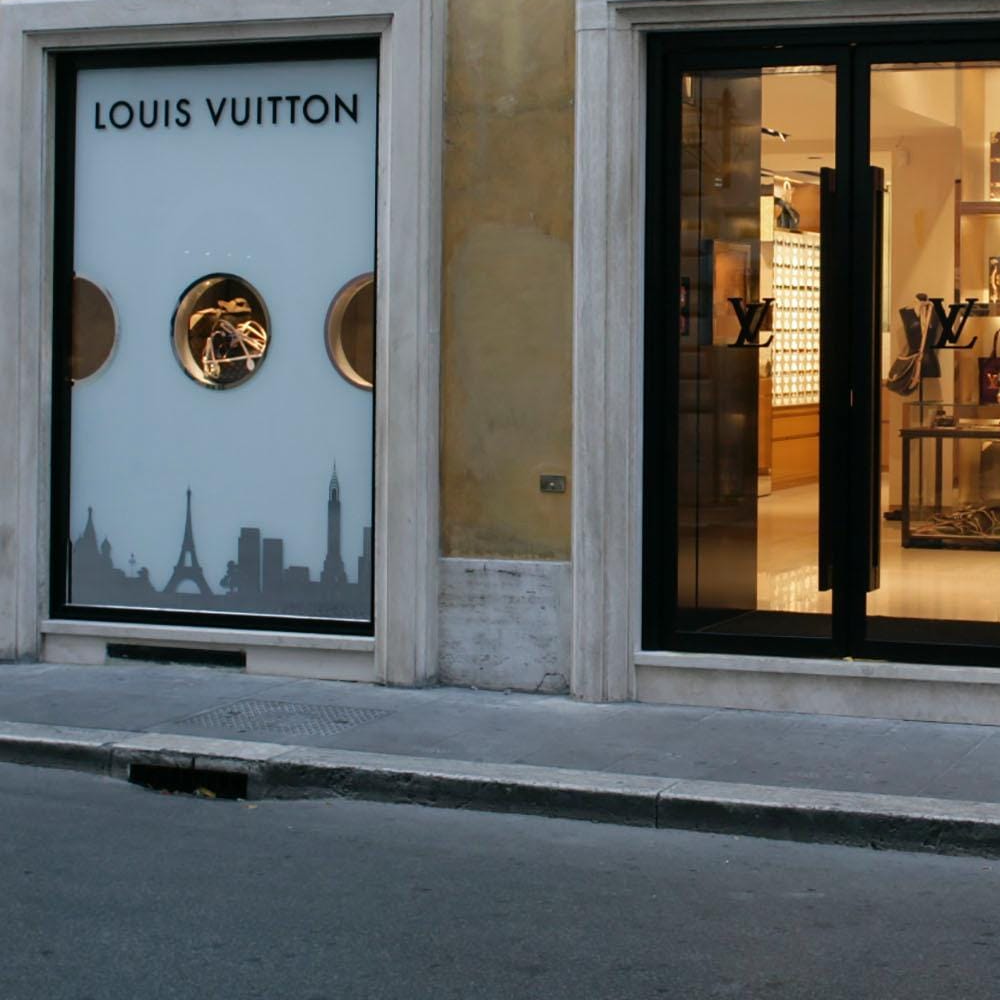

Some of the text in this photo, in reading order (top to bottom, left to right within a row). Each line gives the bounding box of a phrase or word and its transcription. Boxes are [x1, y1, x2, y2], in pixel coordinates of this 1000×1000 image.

[94, 93, 359, 130] LOUIS VUITTON
[727, 297, 776, 348] LV
[928, 297, 979, 349] LV
